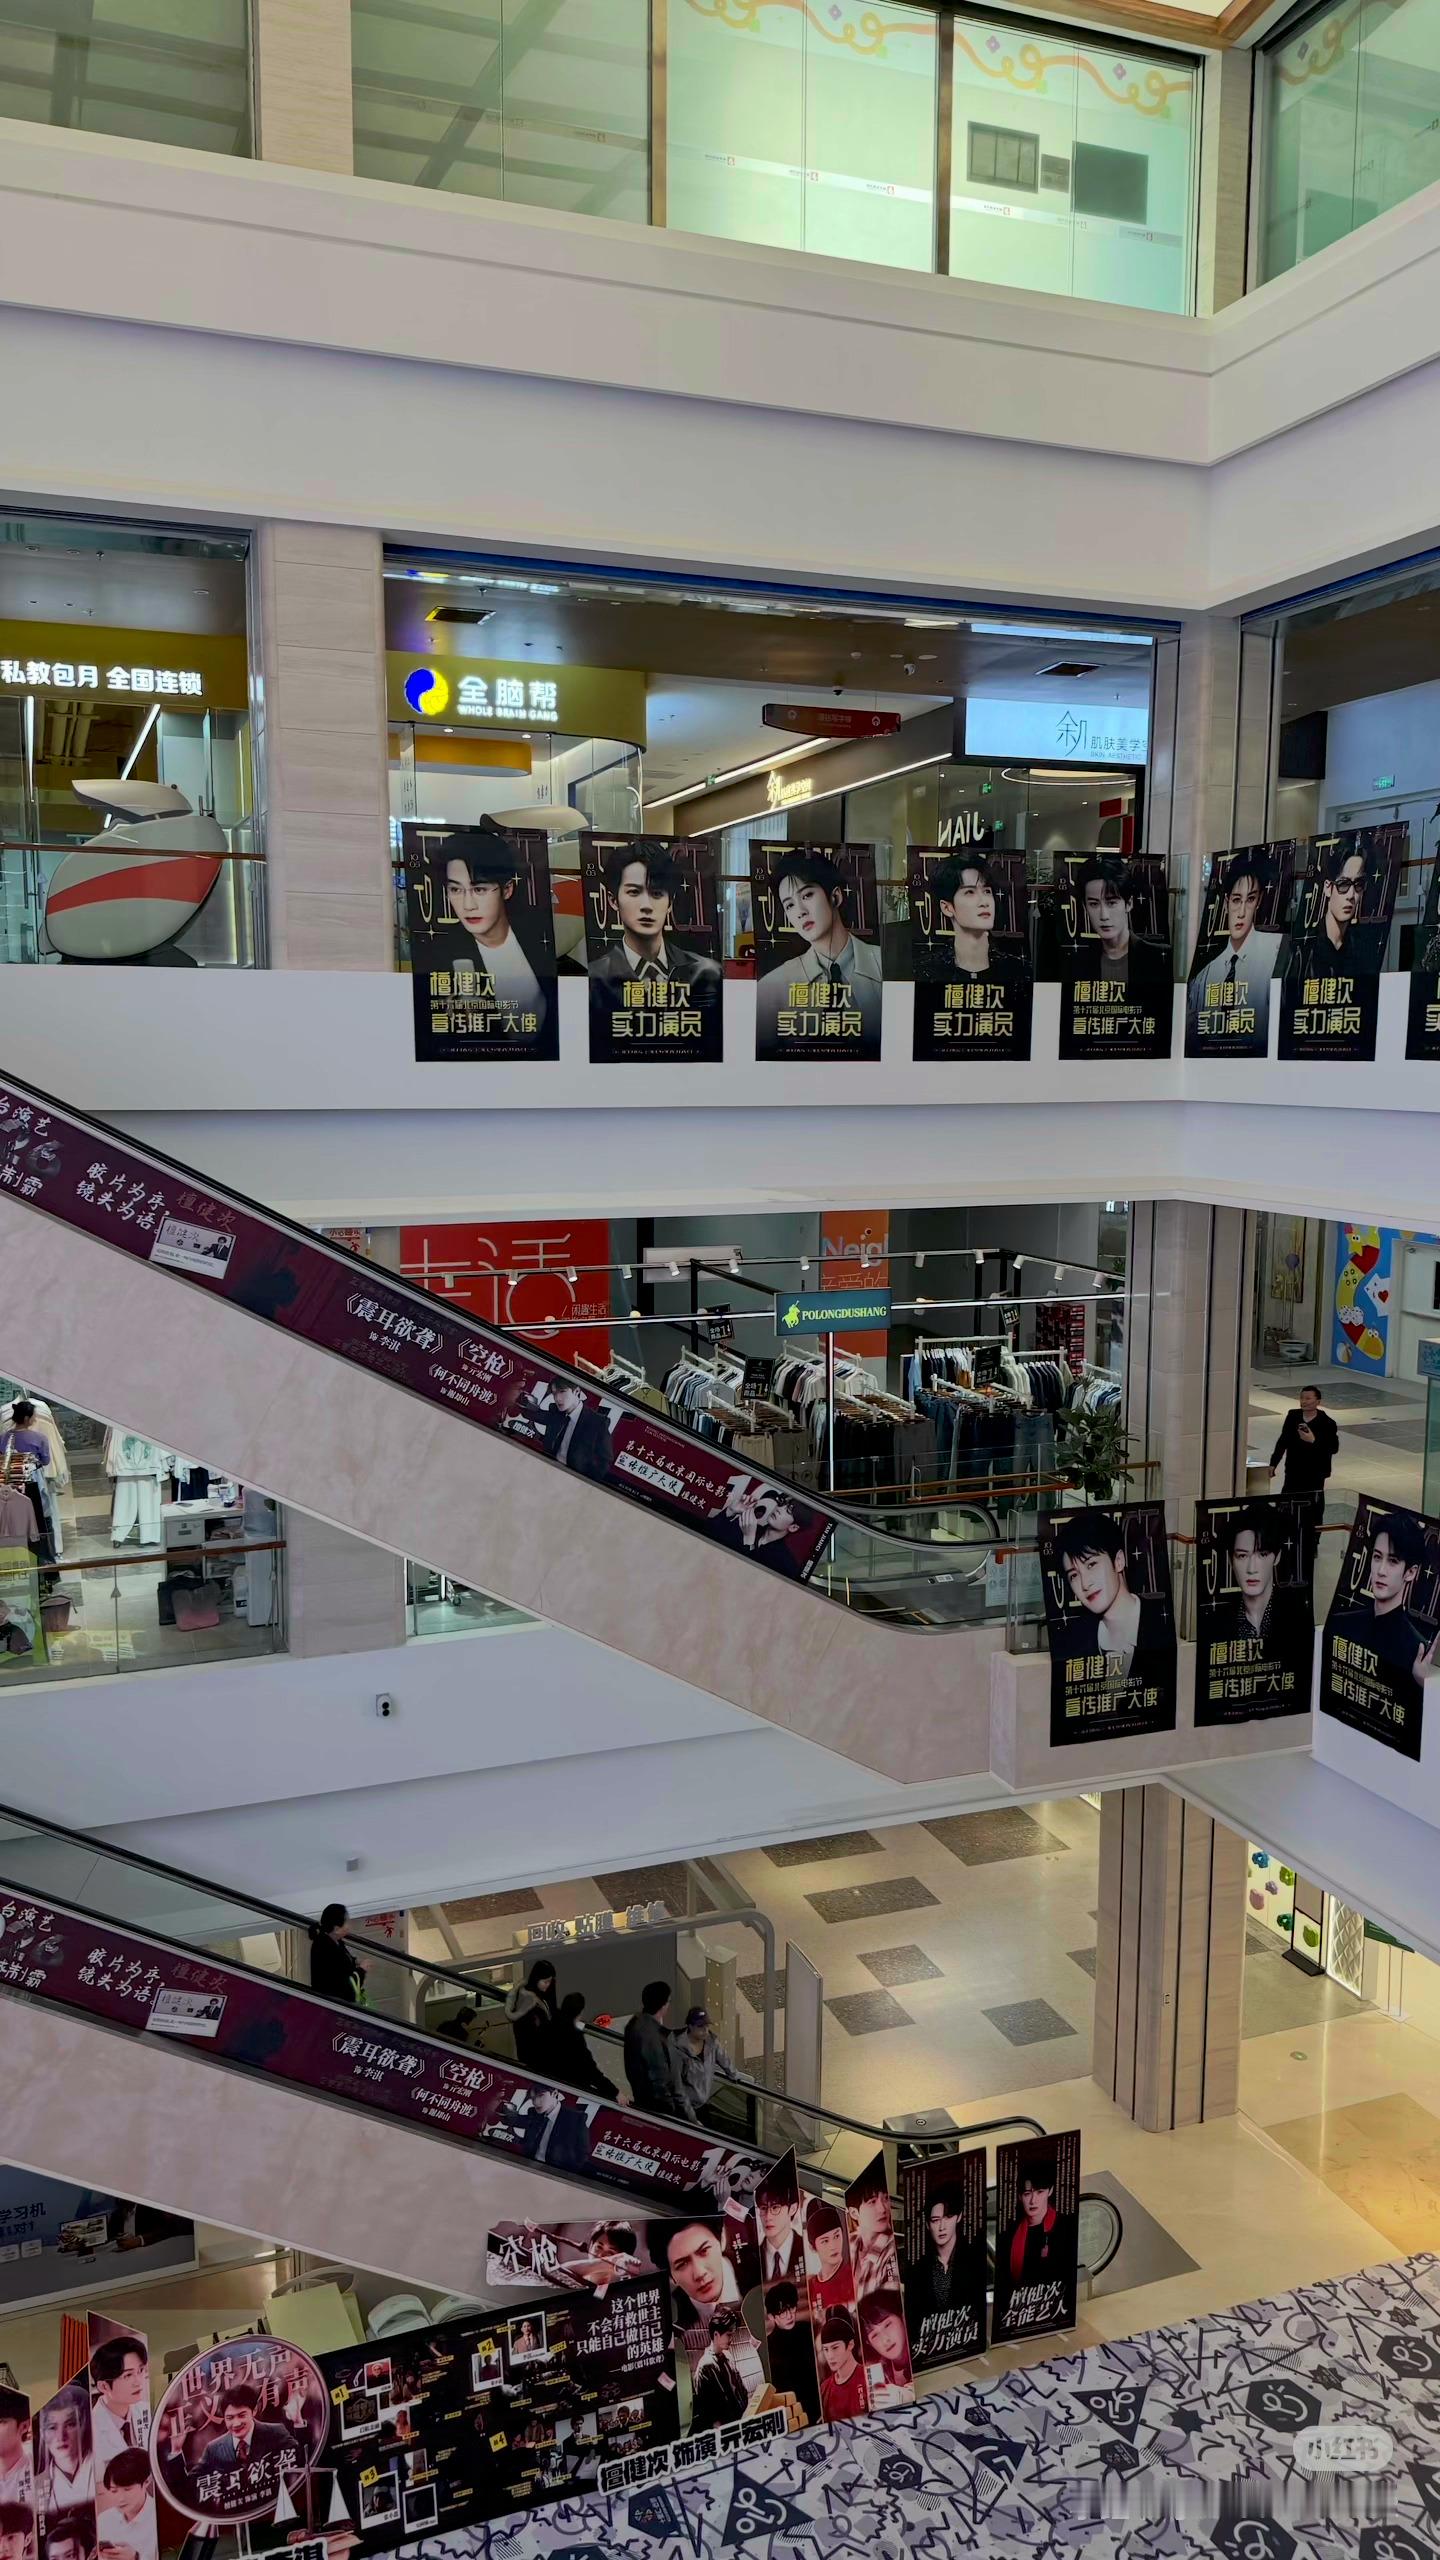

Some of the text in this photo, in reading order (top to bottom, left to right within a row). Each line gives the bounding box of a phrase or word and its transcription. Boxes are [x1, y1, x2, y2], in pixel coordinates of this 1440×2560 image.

[0, 659, 203, 696] 私教包月 全国连锁
[457, 675, 558, 710] 全脑帮
[456, 703, 559, 722] WHOLE BRAIN GANG
[430, 971, 496, 997] 檀健次
[623, 981, 691, 1008] 檀健次
[788, 983, 852, 1009] 檀健次
[944, 984, 1005, 1009] 檀健次
[1073, 980, 1126, 1003] 檀健次
[1205, 981, 1249, 1007] 檀健次
[1303, 977, 1354, 1004] 檀健次
[431, 1012, 537, 1034] 宣传推广大使
[611, 1011, 702, 1038] 实力演员
[777, 1011, 862, 1037] 实力演员
[933, 1011, 1014, 1037] 实力演员
[1073, 1016, 1156, 1035] 宣传推广大使
[1197, 1007, 1256, 1035] 实力演员
[1293, 1007, 1361, 1035] 实力演员
[346, 1292, 443, 1354] 《震耳欲聋》
[801, 1306, 887, 1321] POLONGDUSHANG
[458, 1338, 514, 1379] 《空枪》
[625, 1440, 735, 1499] 第十六届北京国际电影
[1209, 1638, 1264, 1666] 檀健次
[1332, 1635, 1379, 1677] 檀健次
[1065, 1653, 1125, 1683] 檀健次
[1209, 1671, 1295, 1700] 宣传推广大使
[1331, 1672, 1406, 1727] 宣传推广大使
[1065, 1687, 1158, 1718] 宣传推广大使
[331, 2031, 425, 2079] 《震耳欲聋》
[440, 2059, 494, 2093] 《空枪》
[602, 2130, 703, 2172] 第十六届北京国际电影
[611, 2287, 660, 2314] 这个世界
[586, 2305, 662, 2337] 不会有救世主
[1002, 2303, 1068, 2328] 全能艺人
[576, 2321, 663, 2357] 只能自己做自己
[626, 2337, 665, 2360] 的英雄
[181, 2346, 293, 2401] 世界无声
[601, 2450, 668, 2493] 檀健次
[673, 2433, 717, 2469] 饰演
